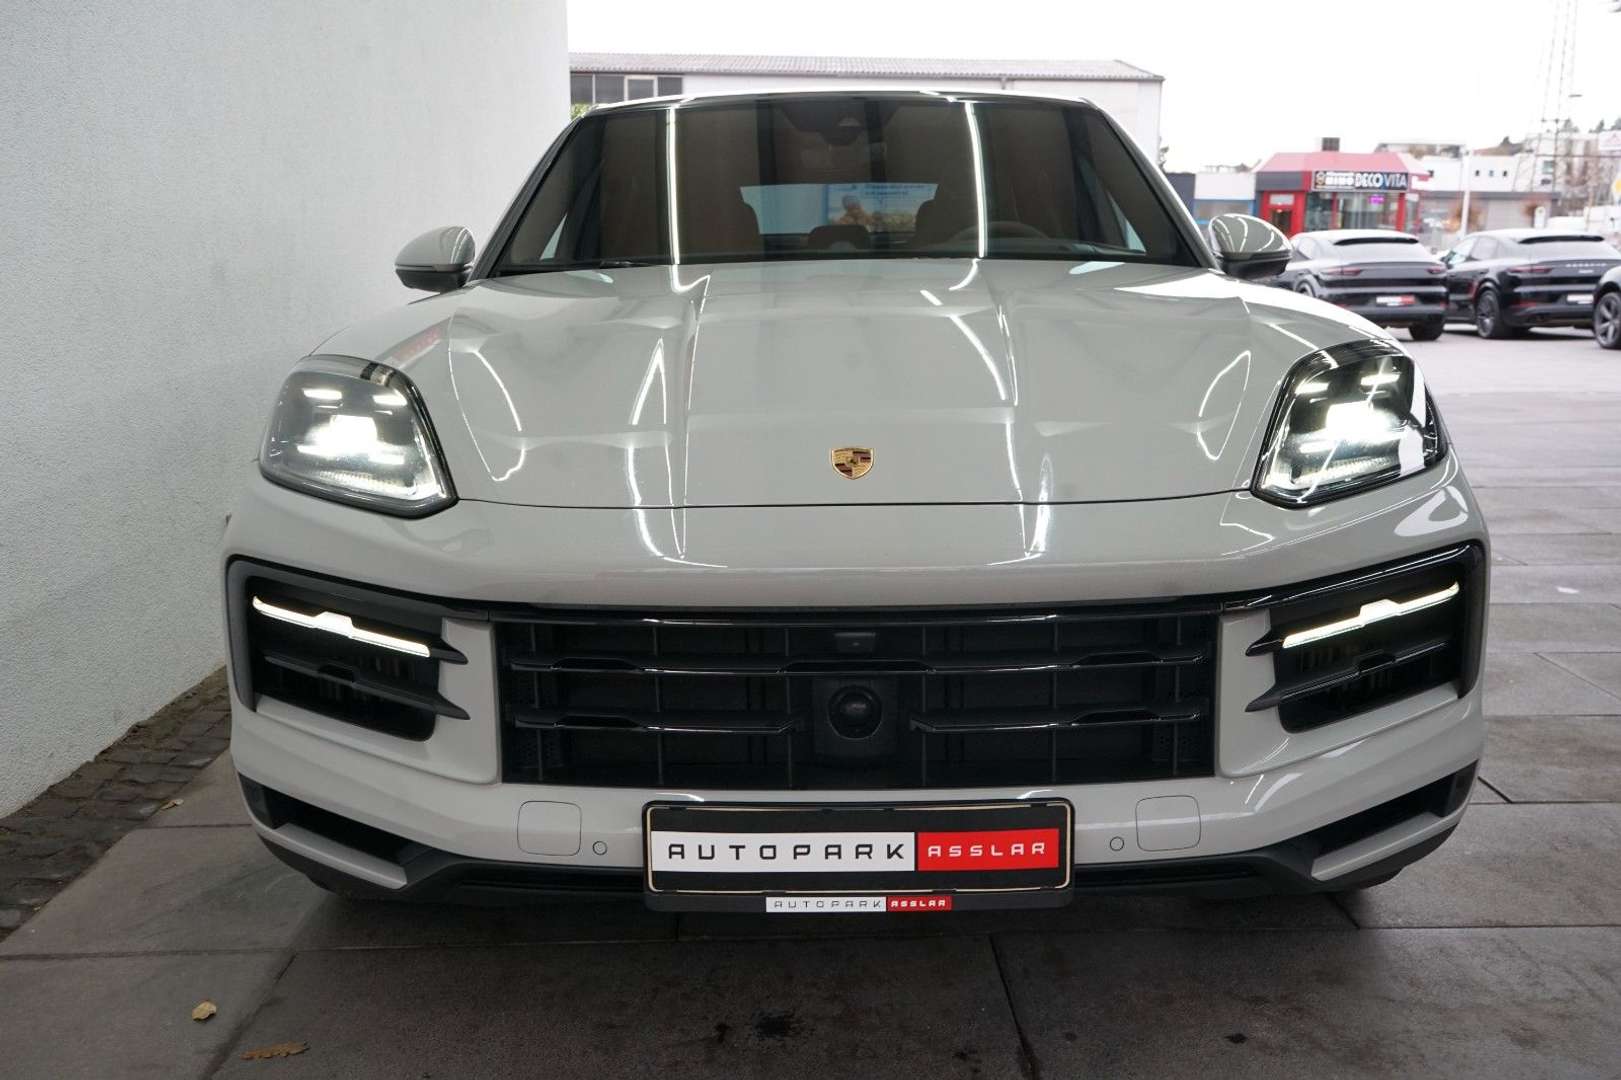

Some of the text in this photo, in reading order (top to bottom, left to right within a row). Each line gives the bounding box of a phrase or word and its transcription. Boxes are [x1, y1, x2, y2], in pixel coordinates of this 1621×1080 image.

[668, 842, 1047, 860] AUTOPARK ASSLAR
[773, 899, 948, 910] AUTOPARK ASSLAR
